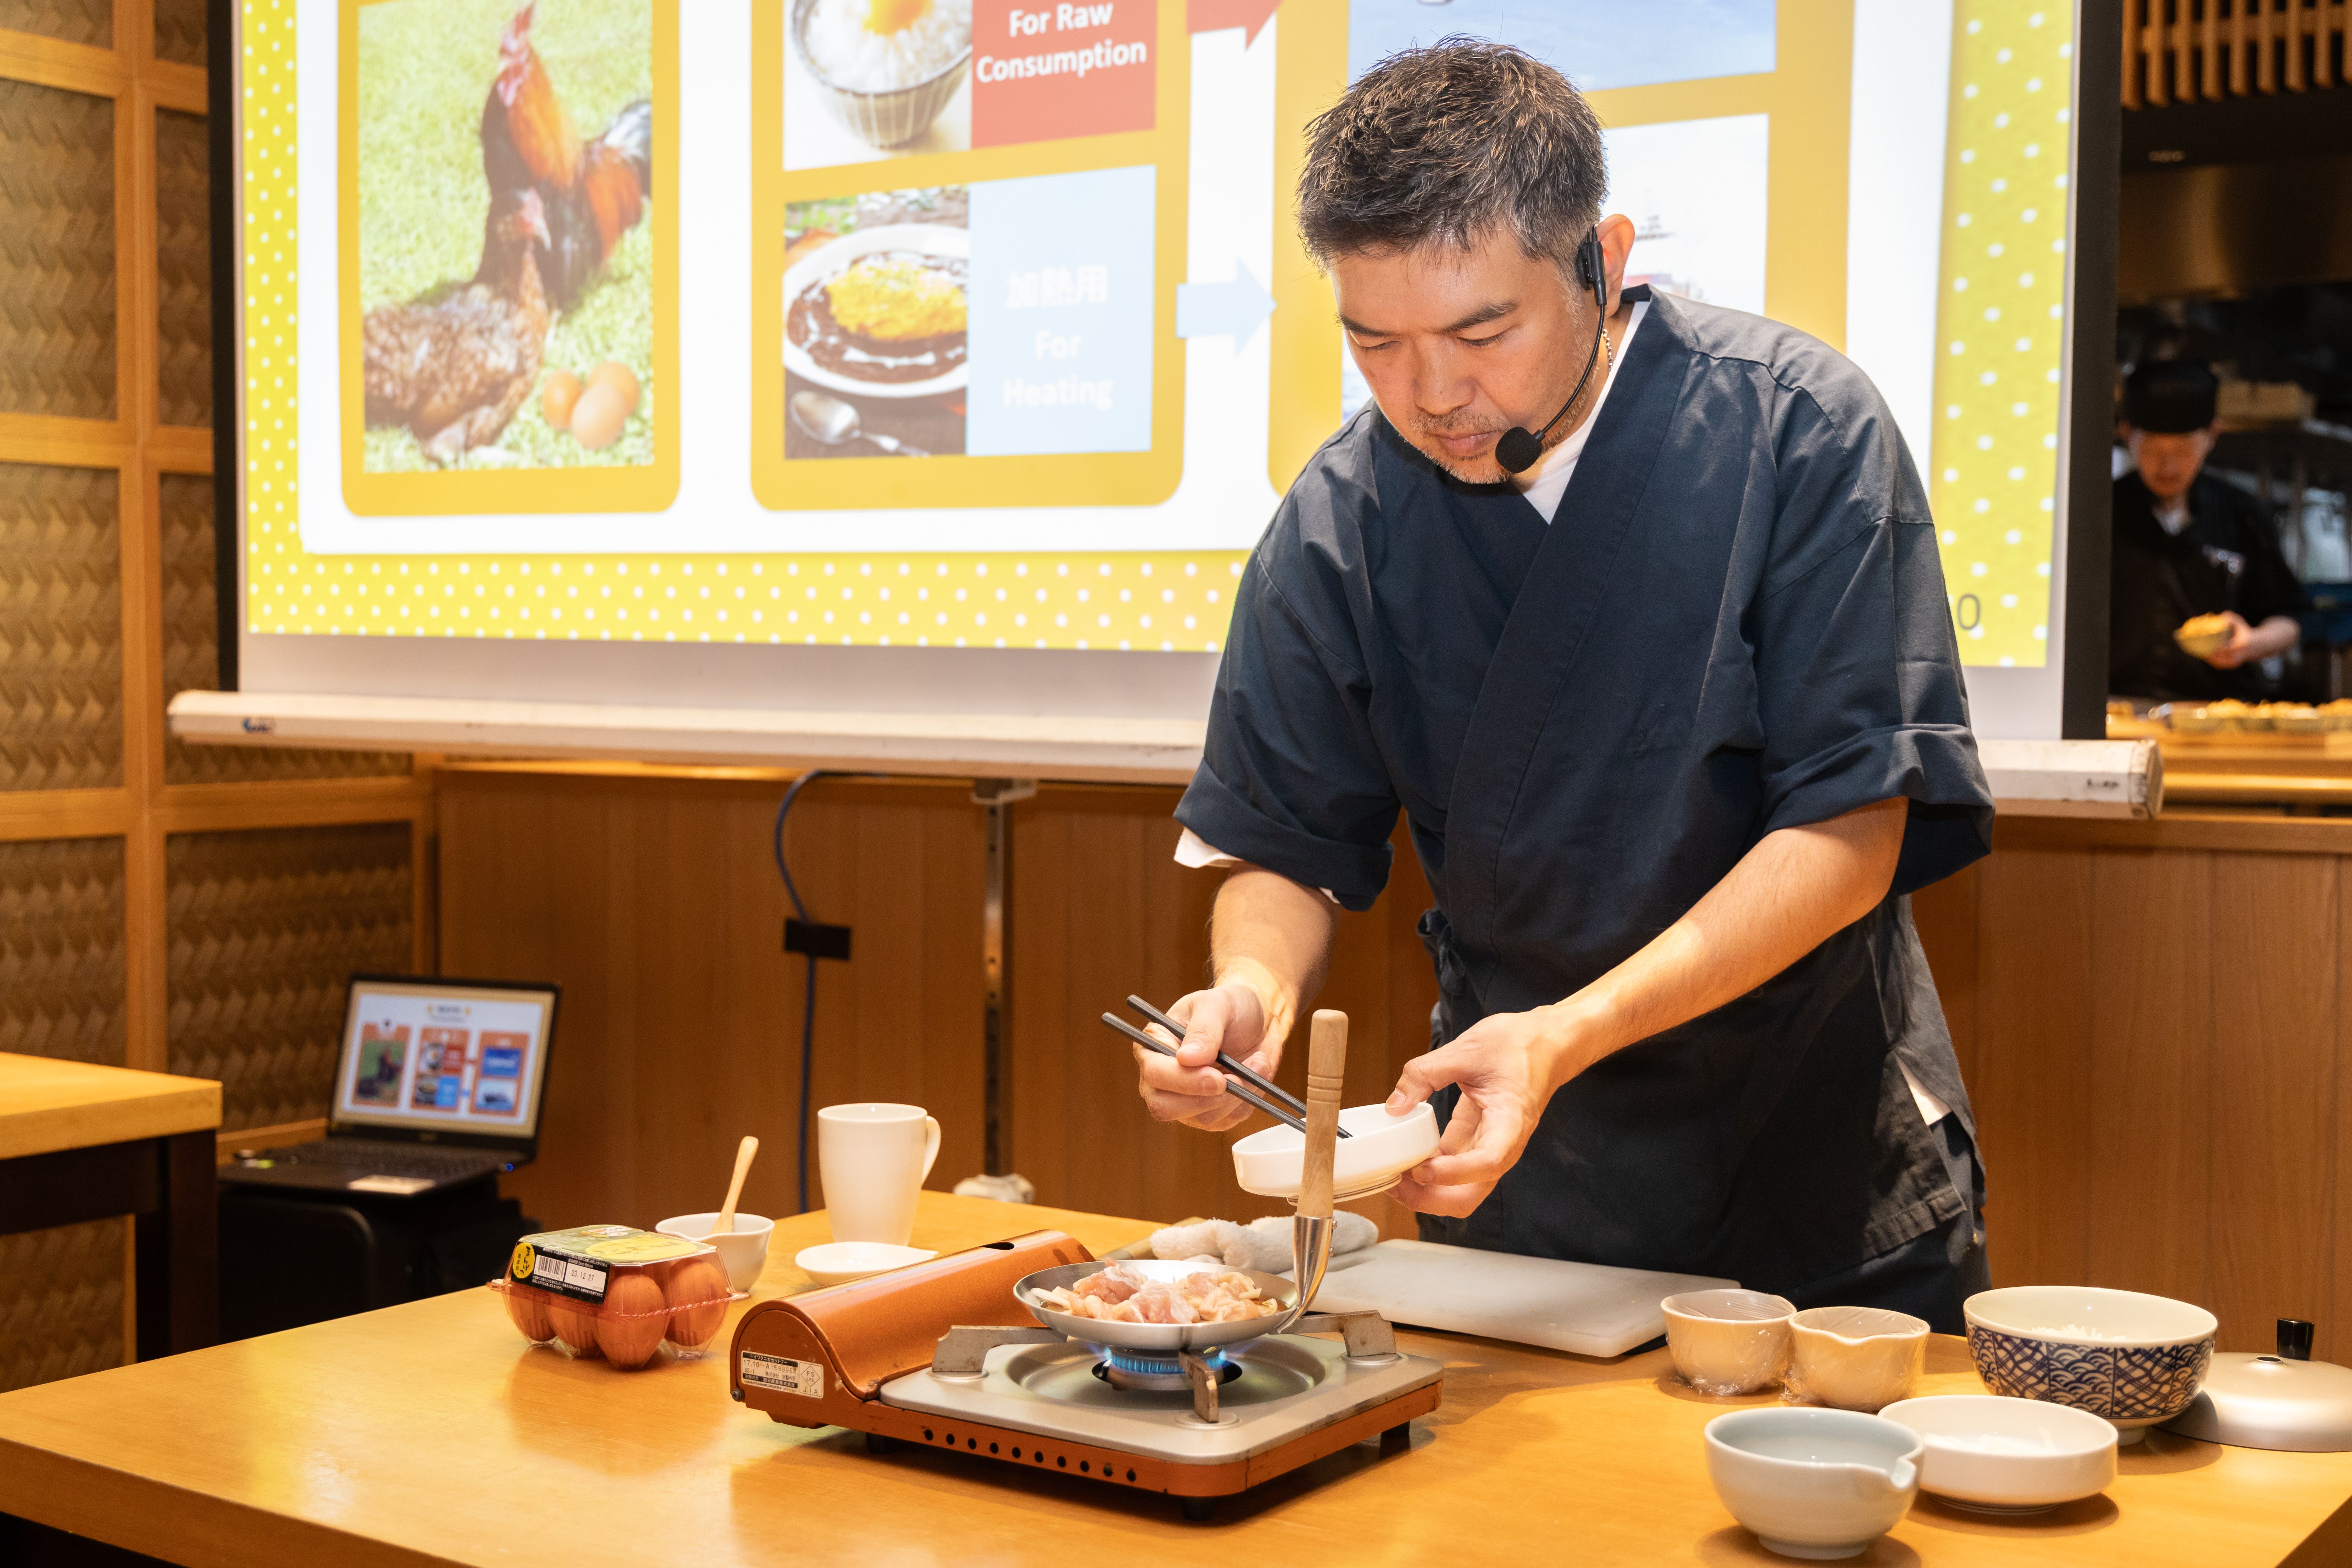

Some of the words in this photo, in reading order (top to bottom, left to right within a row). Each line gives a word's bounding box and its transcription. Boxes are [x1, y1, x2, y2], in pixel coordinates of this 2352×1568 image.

[1009, 9, 1051, 37] For
[1056, 2, 1113, 31] Raw
[976, 38, 1147, 83] Consumption
[1006, 265, 1108, 309] 加熱用
[1035, 330, 1082, 361] For
[1003, 373, 1114, 411] Heating
[571, 1269, 594, 1281] 23.12.27
[754, 1354, 787, 1364] イワタニカセットフー
